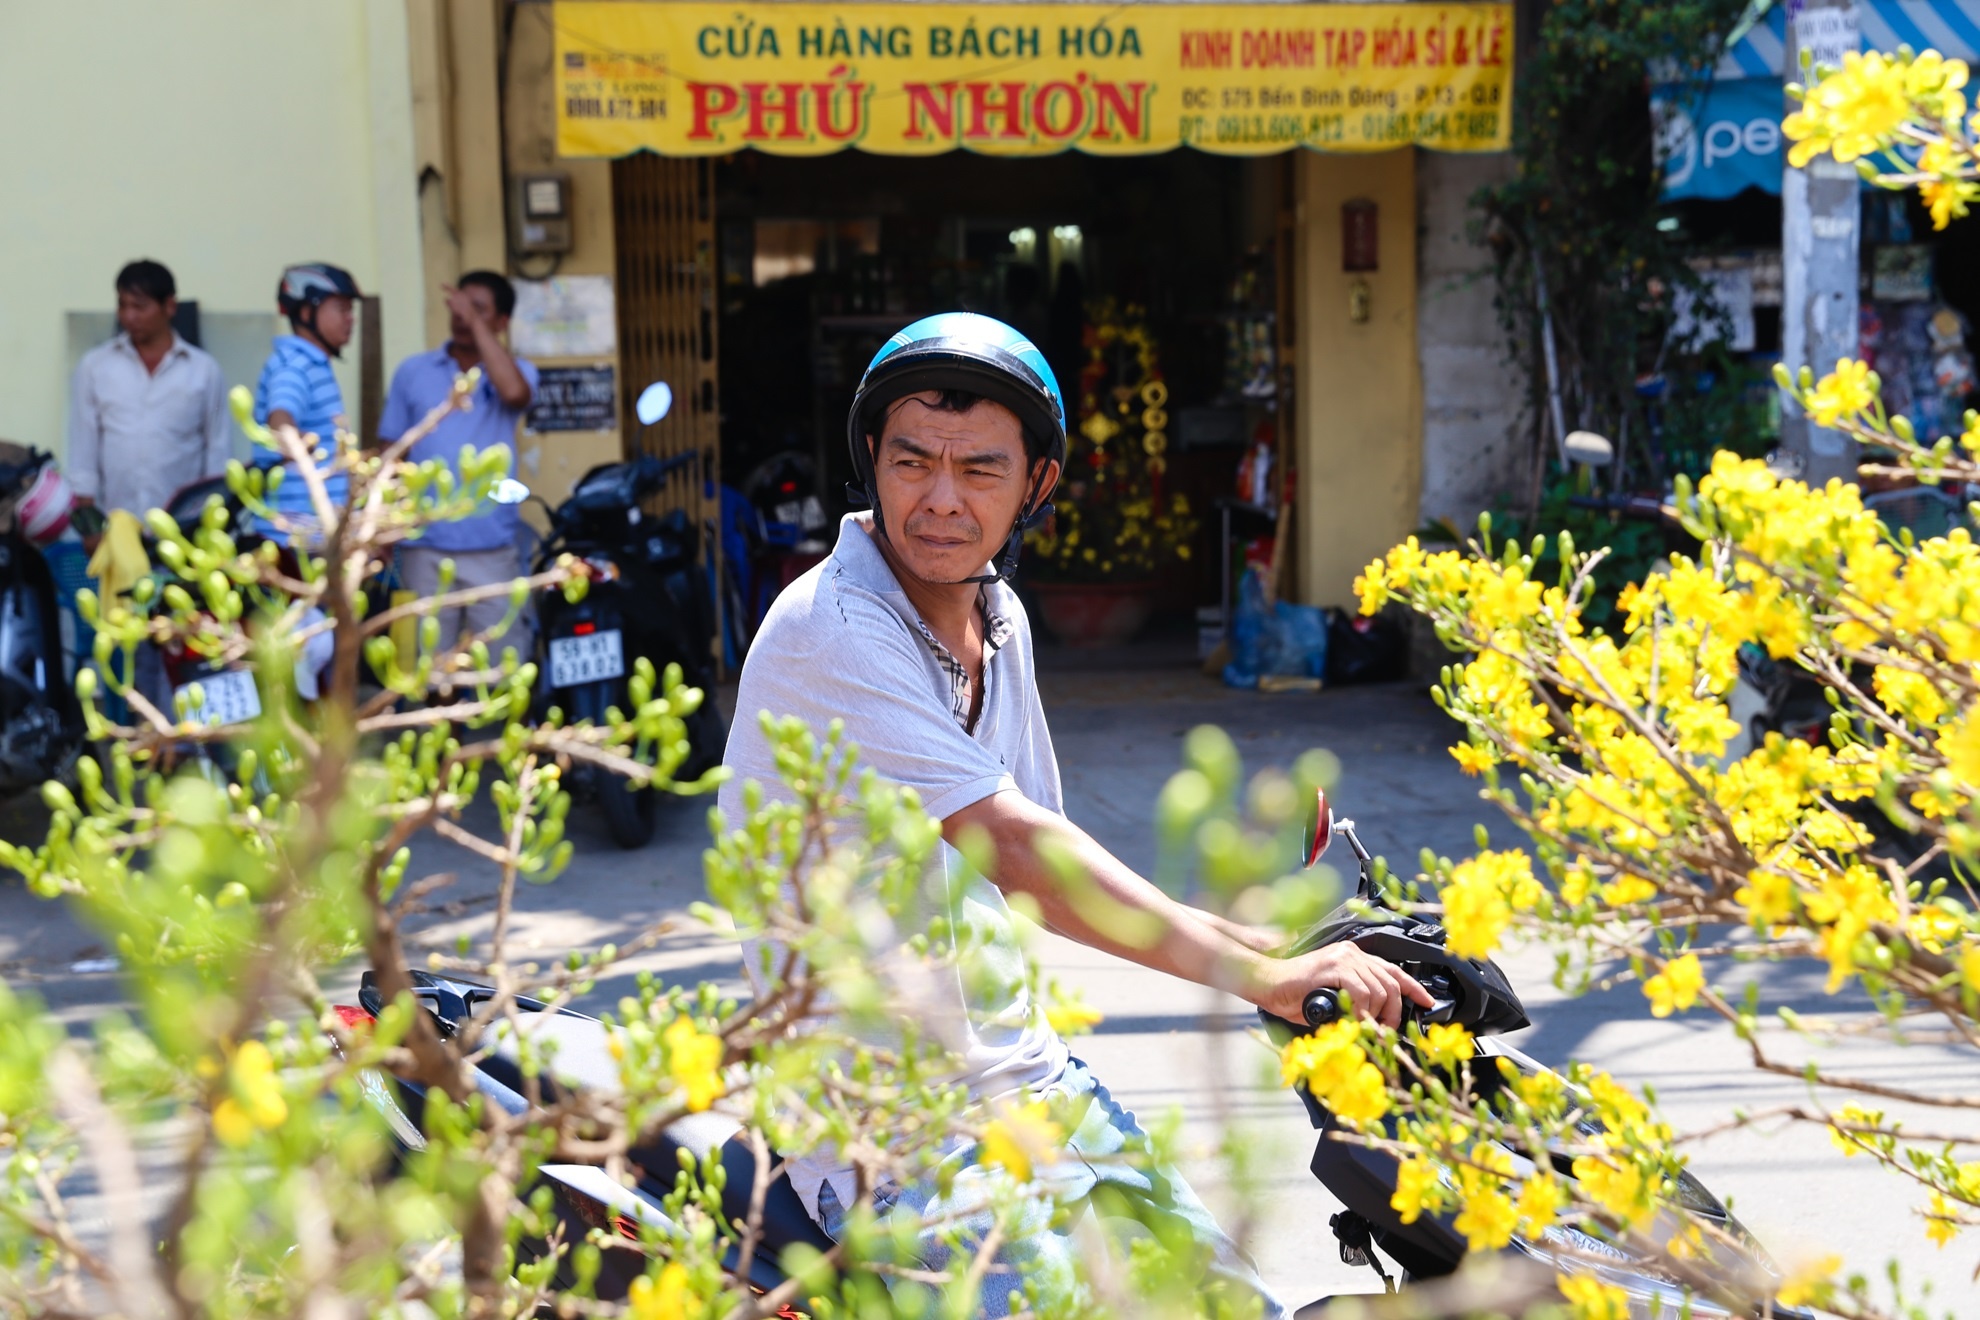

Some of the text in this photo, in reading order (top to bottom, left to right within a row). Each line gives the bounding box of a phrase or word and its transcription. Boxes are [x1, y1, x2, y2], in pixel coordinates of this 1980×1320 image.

[697, 14, 1142, 58] CỬA HÀNG BÁCH HÓA
[1180, 29, 1232, 69] KINH
[1241, 29, 1316, 68] DOANH
[1323, 28, 1367, 76] TẠP
[1373, 17, 1418, 67] HÓA
[1451, 26, 1470, 66] &
[686, 64, 1156, 142] PHÚ NHƠN
